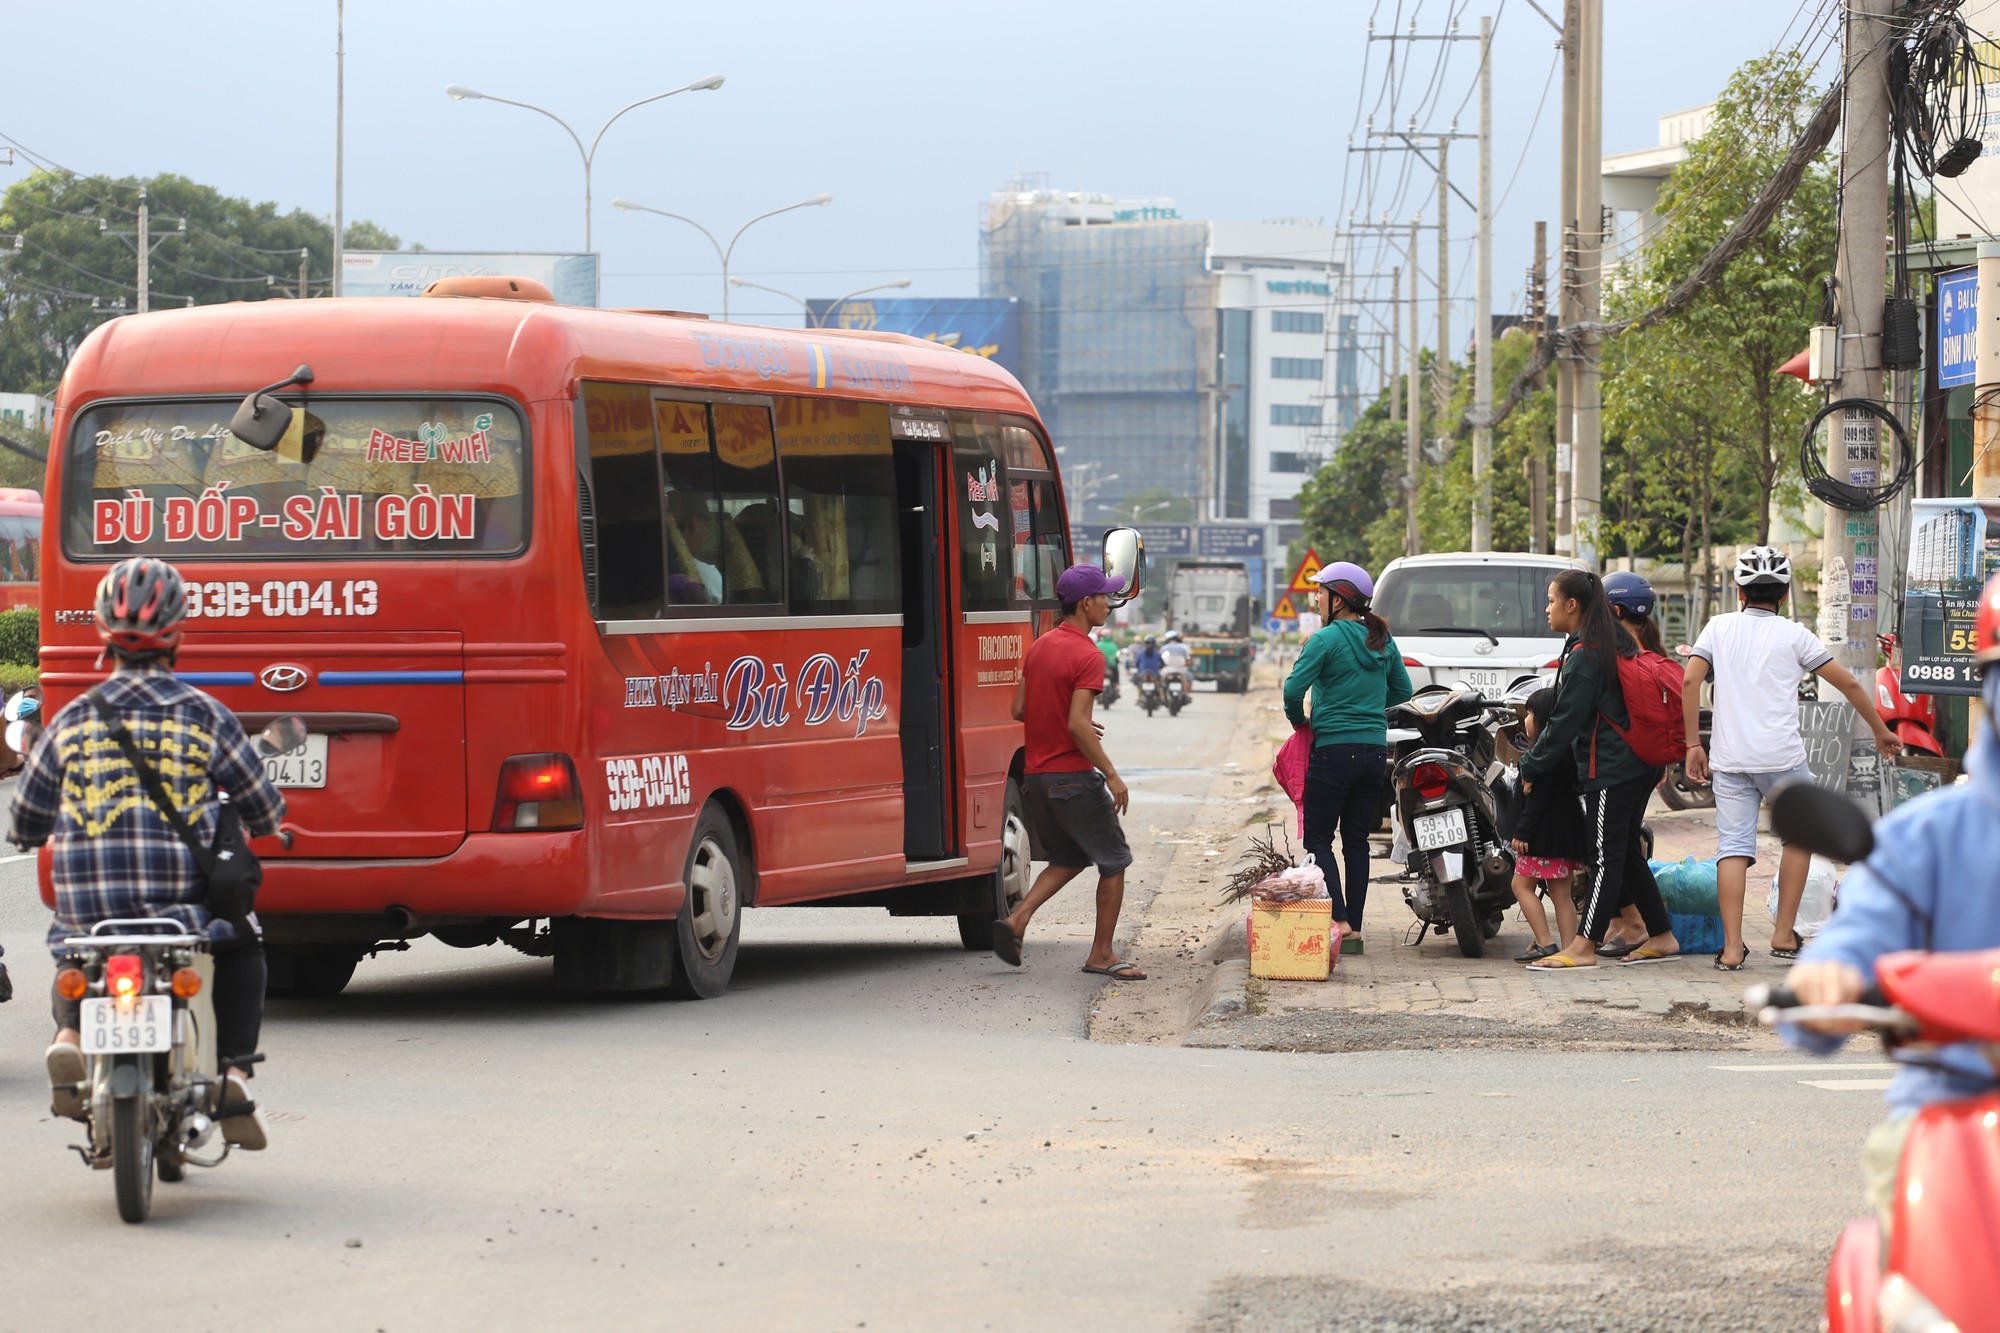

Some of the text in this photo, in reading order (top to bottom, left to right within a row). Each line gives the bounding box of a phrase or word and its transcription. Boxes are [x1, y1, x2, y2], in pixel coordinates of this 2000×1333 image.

[390, 265, 485, 280] CITY
[1958, 289, 1969, 313] ĐẠI
[1943, 328, 1961, 367] BÌNH
[95, 423, 234, 448] Dịch Vụ Du Lịc
[366, 428, 490, 463] FREE WIFI
[968, 471, 985, 501] FREE
[94, 489, 154, 544] BÙ
[375, 484, 475, 540] GÒN
[184, 580, 378, 617] 93B-004.13
[978, 634, 1022, 661] TRACOMECO
[1470, 672, 1497, 685] 50LD
[1908, 664, 1955, 681] 0988
[624, 649, 887, 738] HTX VẬN TẢI Bù Đốp
[268, 760, 322, 784] 04.13
[1421, 813, 1456, 833] 59-Y1
[1420, 827, 1464, 848] 285.09
[96, 1026, 156, 1048] 0593
